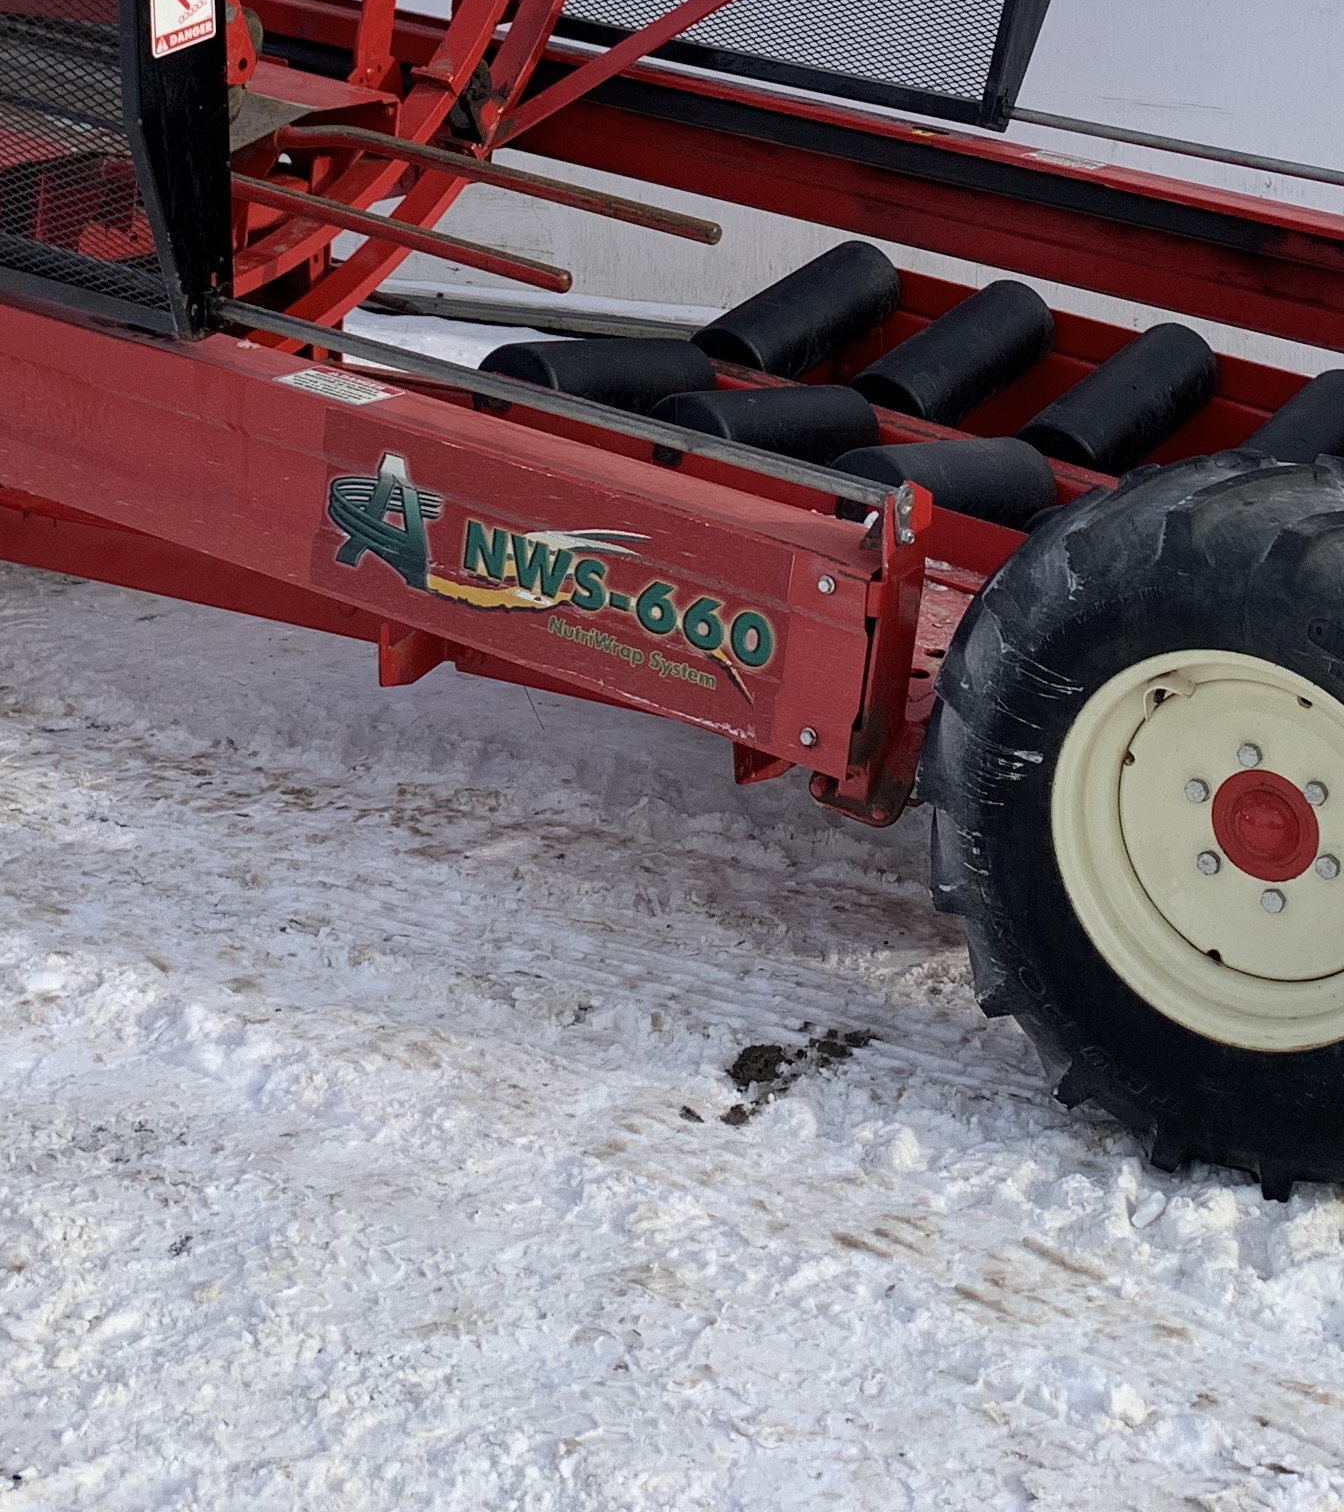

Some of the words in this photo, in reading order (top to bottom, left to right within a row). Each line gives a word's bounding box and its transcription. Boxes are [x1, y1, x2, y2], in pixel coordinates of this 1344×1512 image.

[169, 21, 213, 46] DANGER
[463, 519, 774, 668] NWS-660
[547, 614, 644, 665] NutriWrap
[649, 650, 718, 691] System
